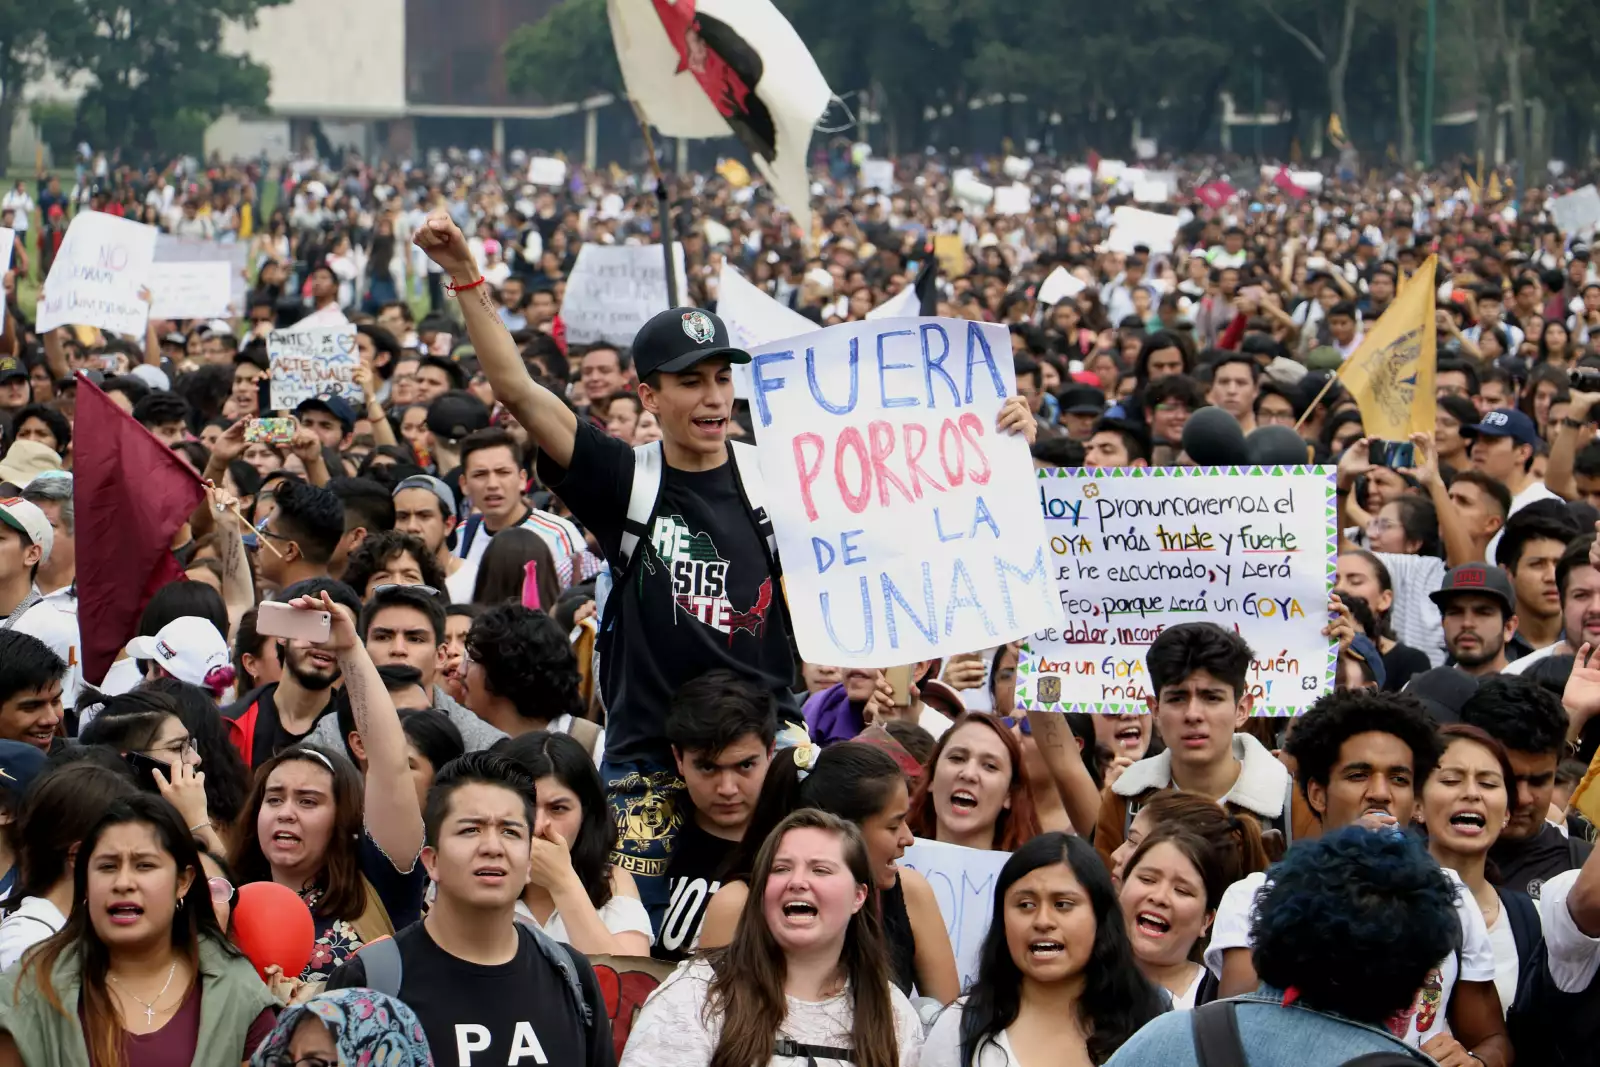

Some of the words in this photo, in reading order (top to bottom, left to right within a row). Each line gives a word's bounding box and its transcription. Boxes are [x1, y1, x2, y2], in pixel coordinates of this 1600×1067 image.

[752, 321, 1007, 427] FUERA
[792, 412, 991, 522] PORROS
[1095, 496, 1269, 533] pronunciaremos
[1274, 488, 1294, 514] el
[652, 516, 691, 560] RE
[811, 529, 867, 574] DE
[933, 496, 1000, 543] LA
[1050, 534, 1092, 556] OYA
[1102, 526, 1151, 551] más
[1154, 524, 1214, 550] triste
[1219, 533, 1232, 556] y
[674, 561, 726, 597] SIS
[1076, 558, 1100, 580] he
[1107, 557, 1216, 583] escuchado,
[1216, 564, 1231, 586] y
[1242, 555, 1291, 579] será
[693, 596, 733, 635] TE
[819, 545, 1055, 657] UNAM
[1101, 596, 1164, 623] porque
[1169, 590, 1208, 612] será
[1214, 597, 1239, 613] un
[1243, 592, 1305, 621] GOYA
[1035, 627, 1059, 642] ue
[1074, 660, 1095, 675] un
[1101, 656, 1145, 679] GOYA
